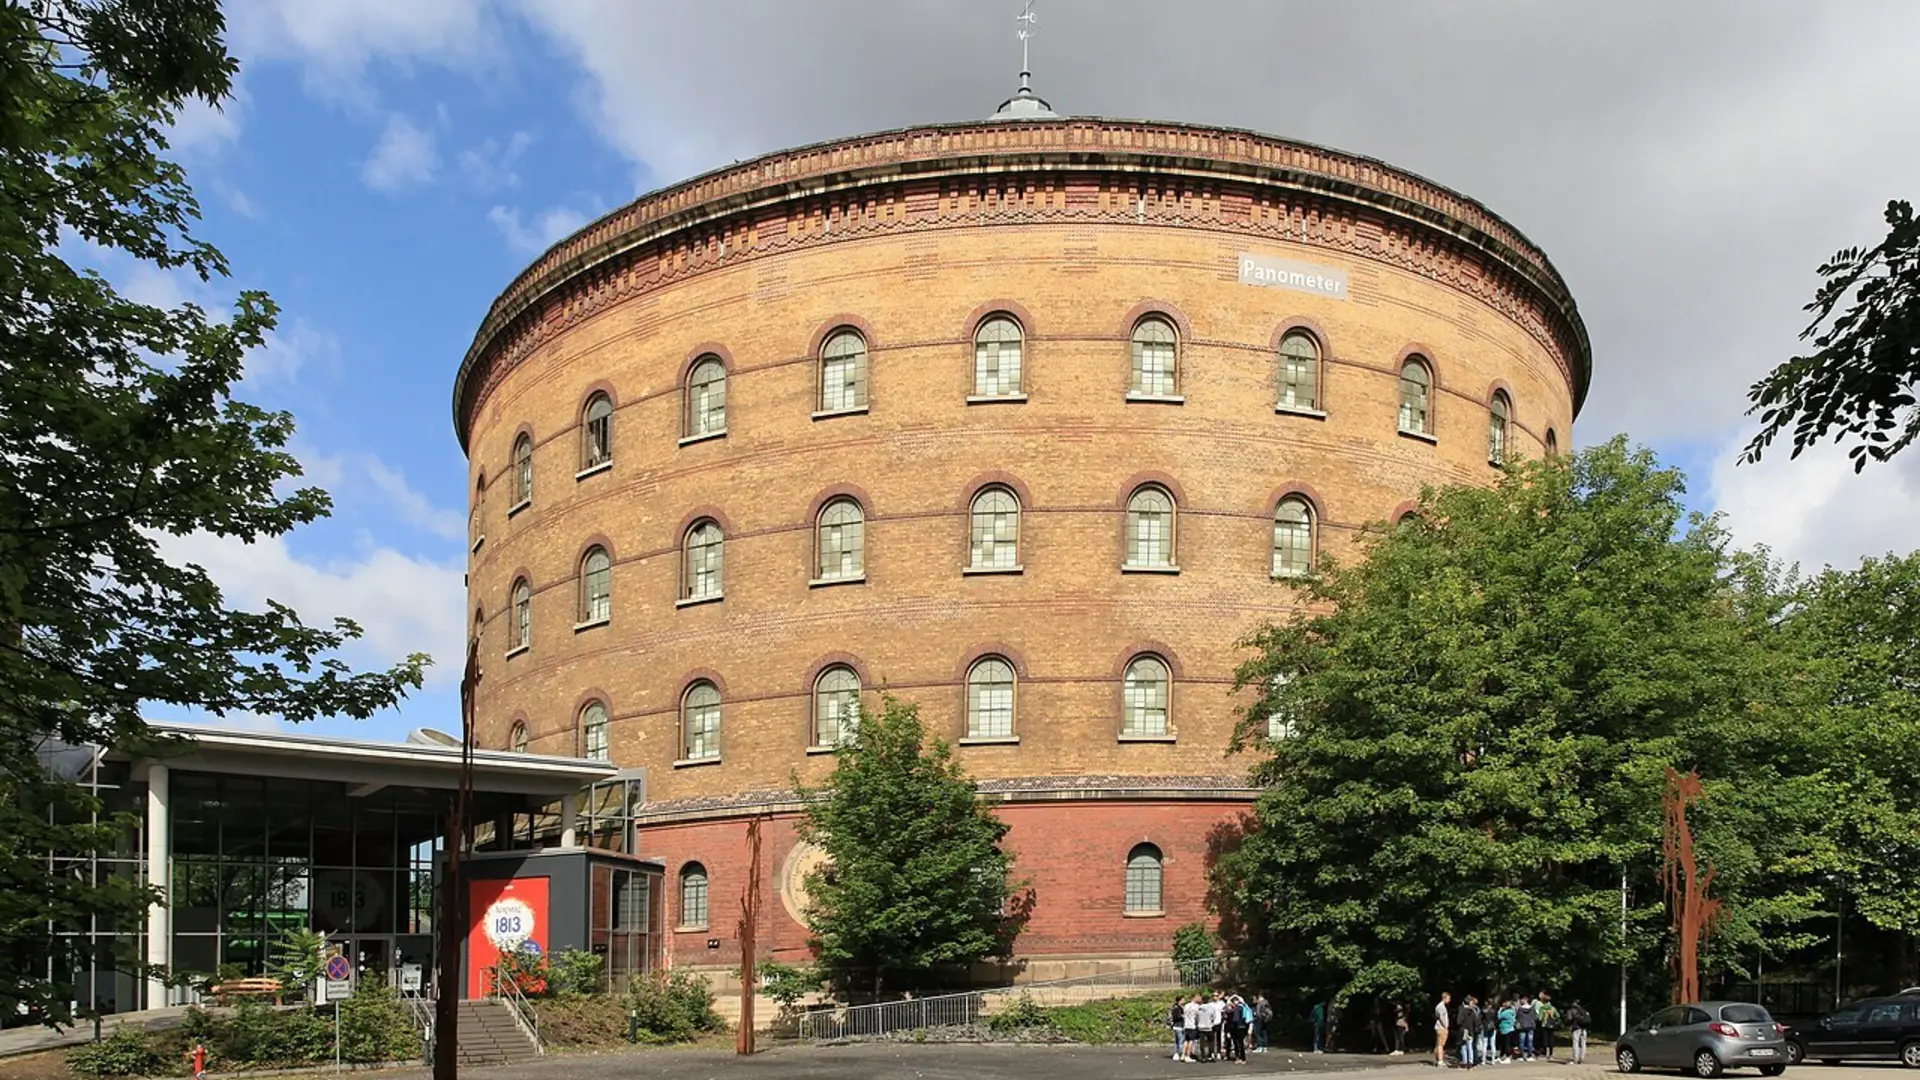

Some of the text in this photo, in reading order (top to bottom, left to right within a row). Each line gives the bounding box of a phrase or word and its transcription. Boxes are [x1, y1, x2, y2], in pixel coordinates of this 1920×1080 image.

[1243, 259, 1342, 294] Panometer
[331, 890, 366, 909] 183
[496, 916, 521, 933] 1813
